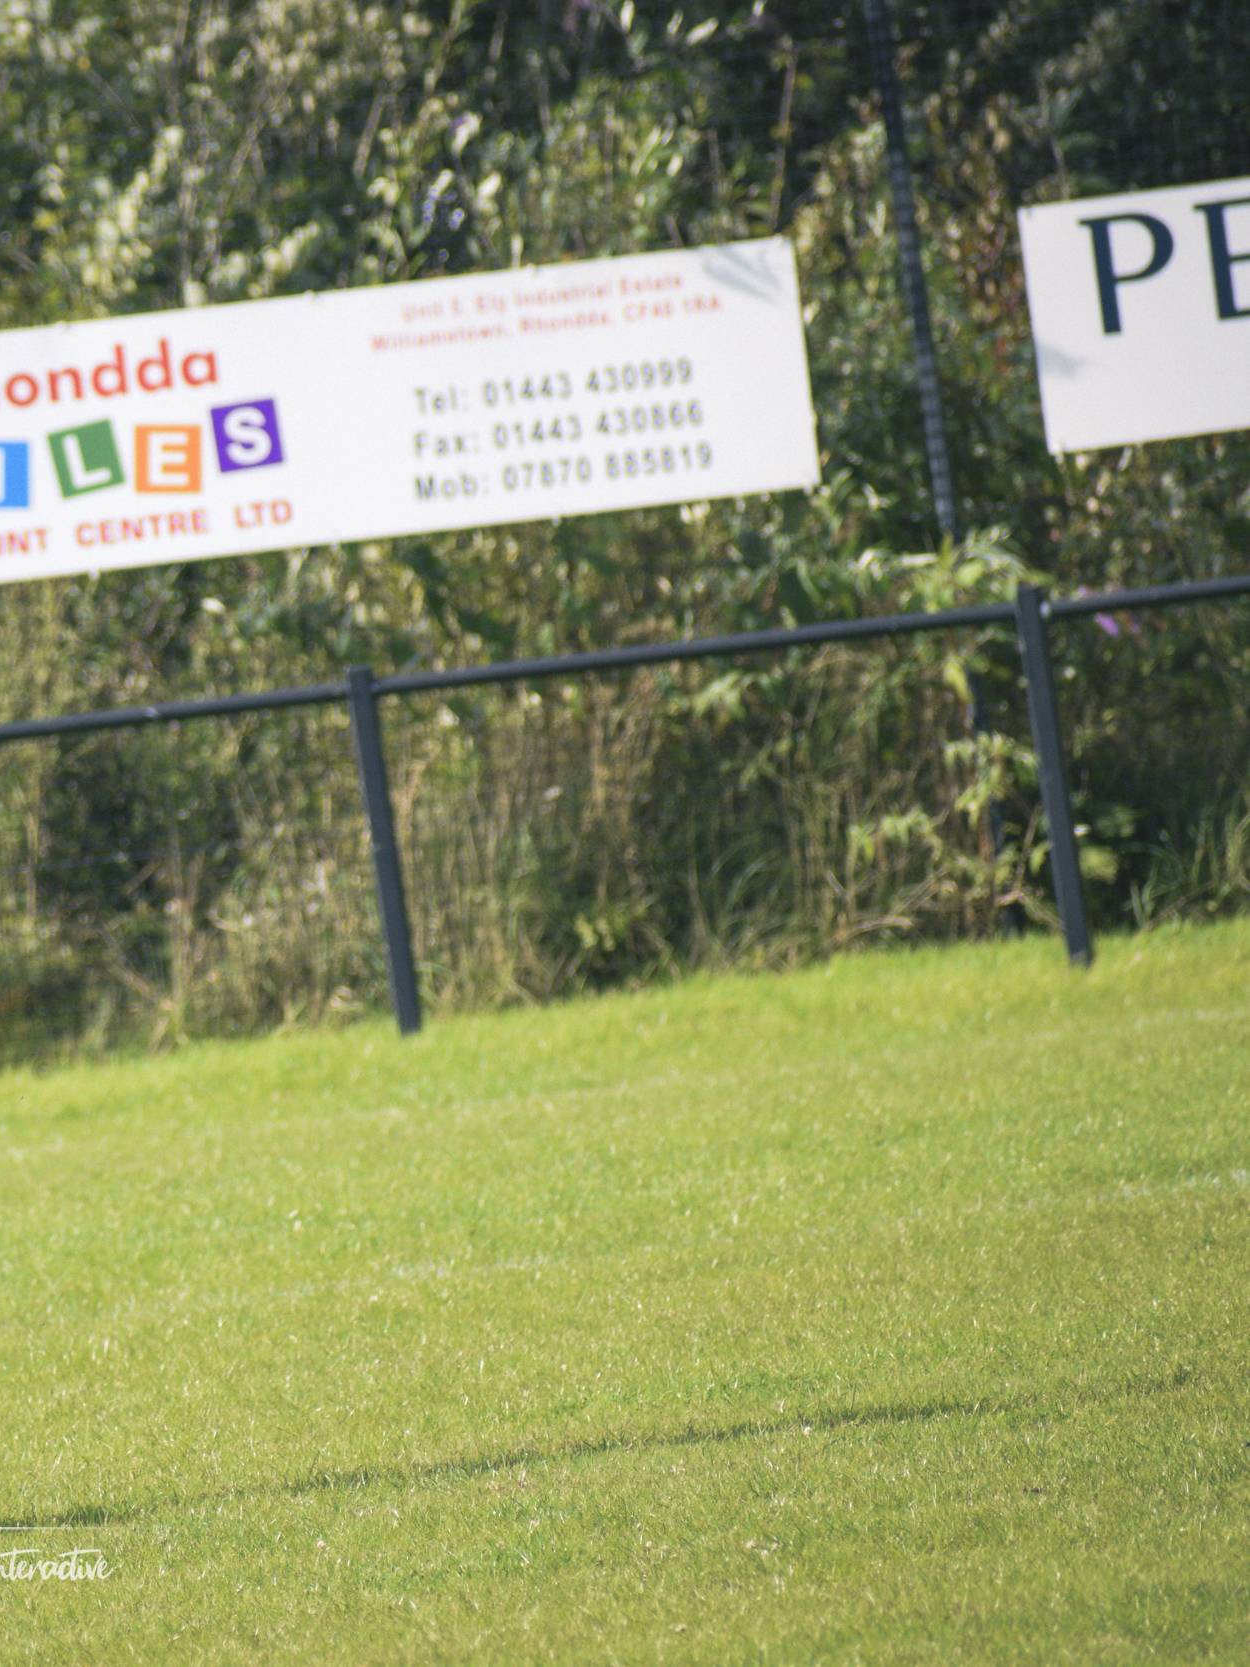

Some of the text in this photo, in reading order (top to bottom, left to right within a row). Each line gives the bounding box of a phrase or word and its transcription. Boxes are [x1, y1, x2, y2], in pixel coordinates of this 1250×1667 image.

[514, 280, 612, 307] Industrial
[619, 275, 683, 296] Estate
[414, 356, 693, 414] Tel: 01443 430999
[414, 399, 703, 458] Fax: 01443 430866
[414, 441, 713, 501] Mob: 07870 885819
[75, 508, 209, 548] CENTRE
[234, 499, 293, 531] LTD
